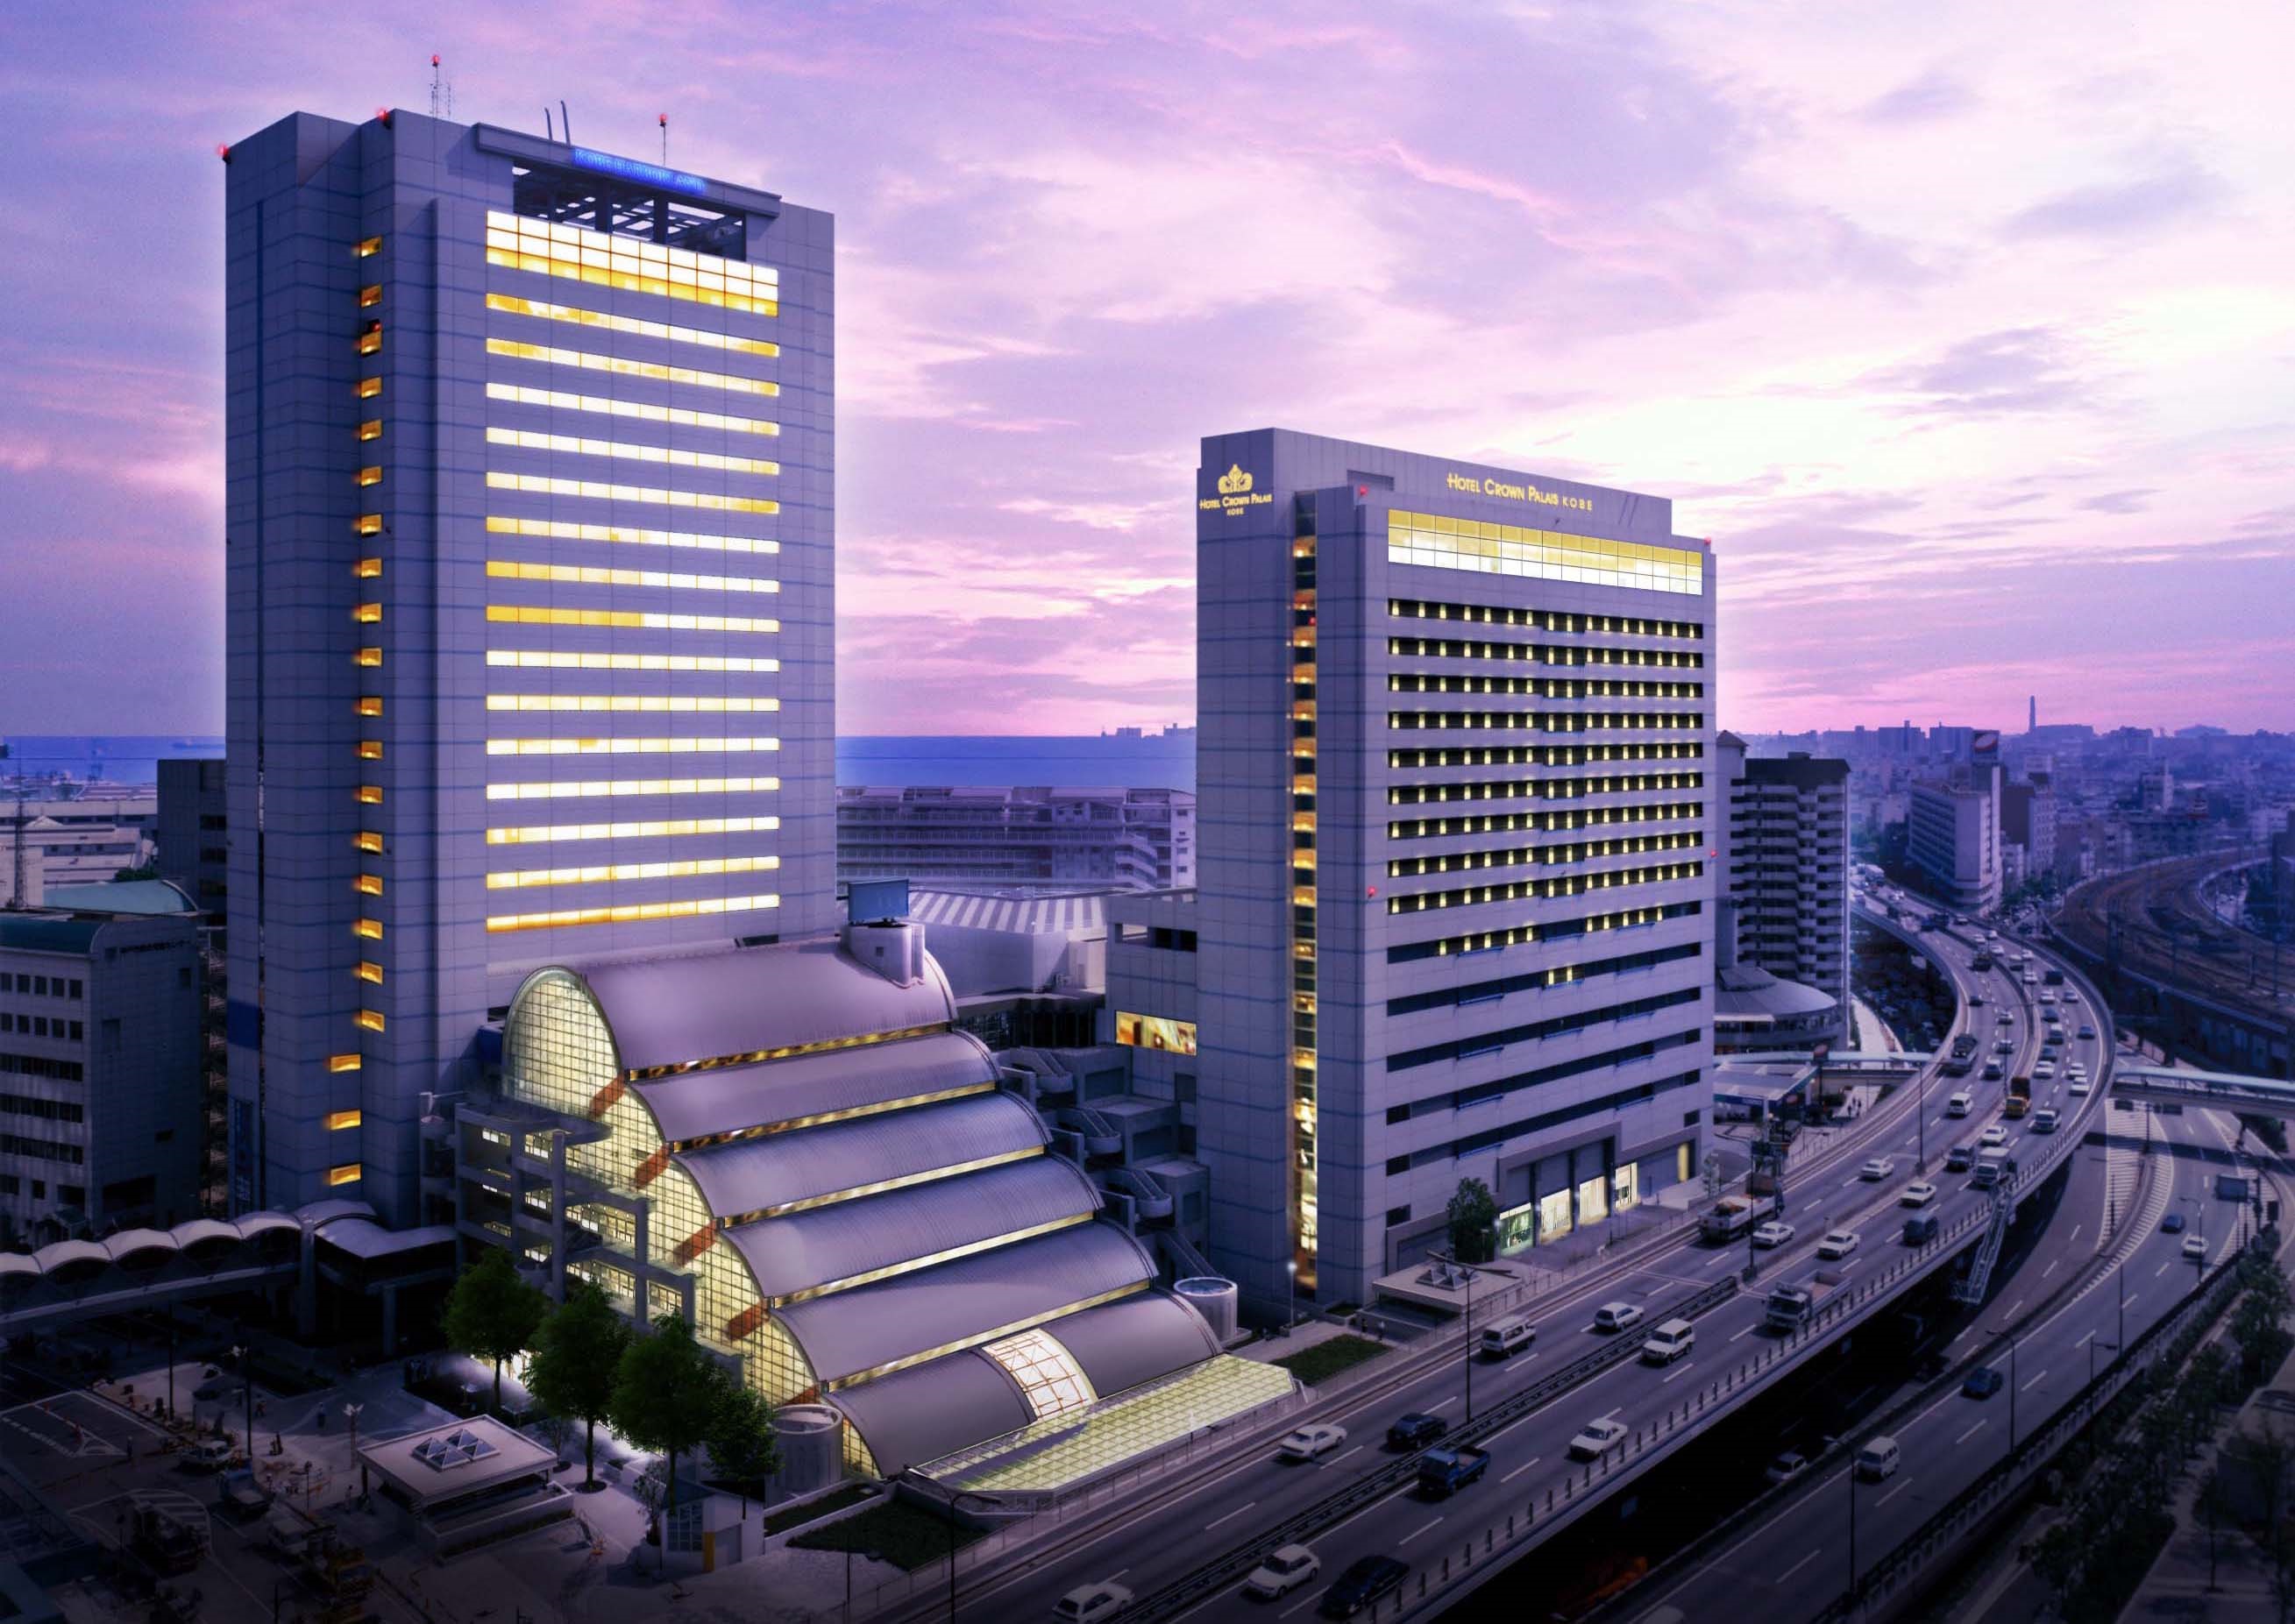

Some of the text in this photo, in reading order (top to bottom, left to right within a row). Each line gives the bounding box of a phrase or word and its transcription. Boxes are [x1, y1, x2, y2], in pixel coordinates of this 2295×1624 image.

[1446, 472, 1480, 493] HOTEL
[1484, 479, 1525, 500] CROWN
[1562, 495, 1593, 512] KOBE
